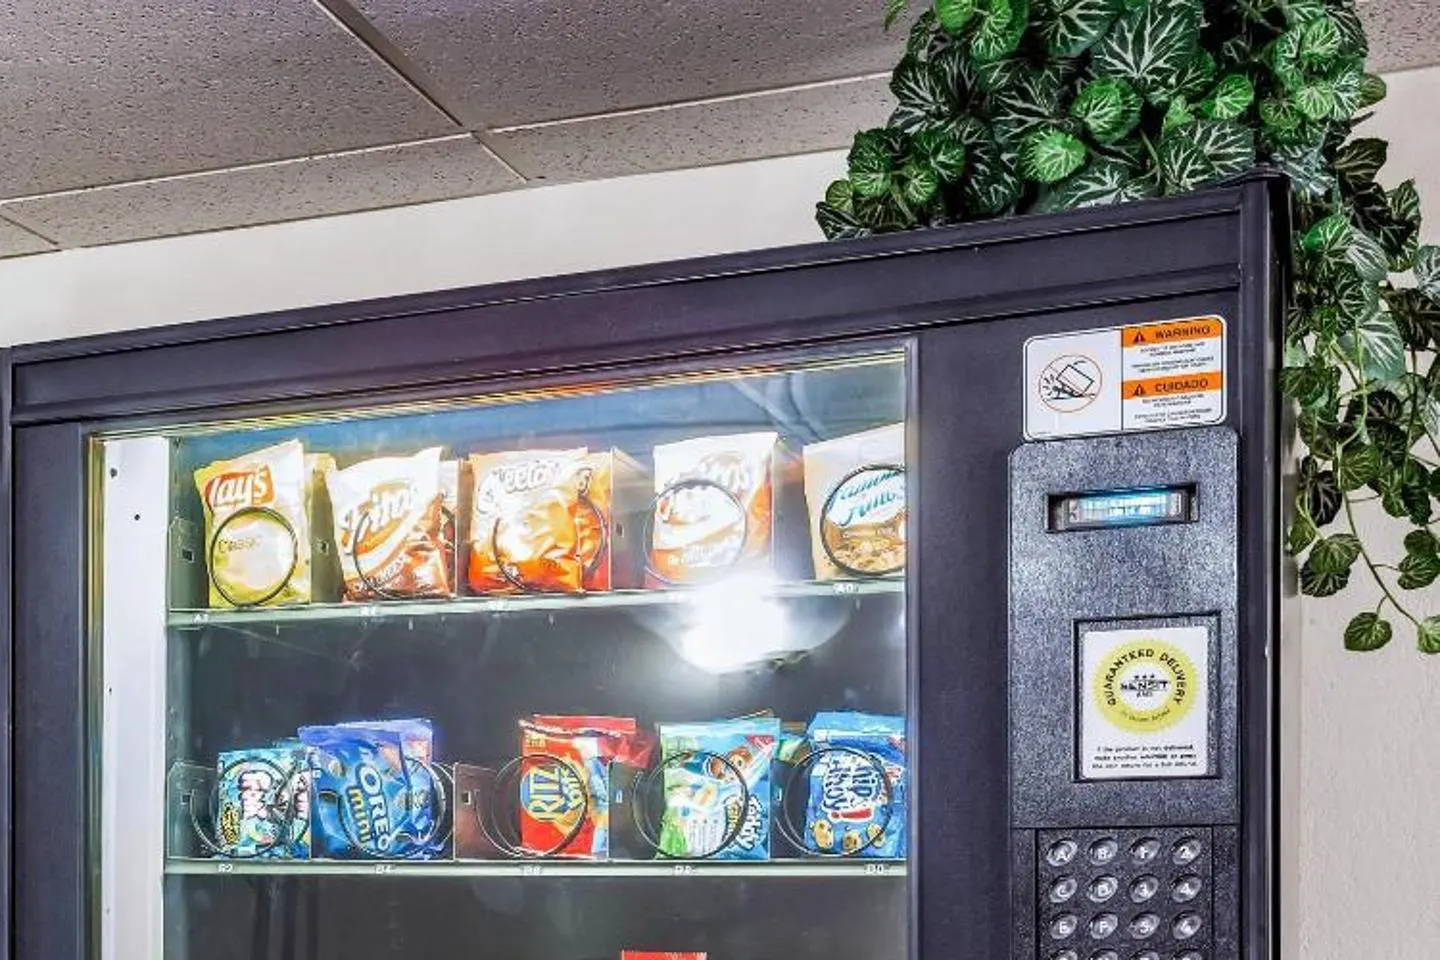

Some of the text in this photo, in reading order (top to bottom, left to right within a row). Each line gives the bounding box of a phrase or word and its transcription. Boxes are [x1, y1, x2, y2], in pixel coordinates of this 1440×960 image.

[1155, 325, 1211, 339] WARNING
[1154, 379, 1209, 392] CUIDADO
[1103, 649, 1187, 706] GUARANTEED DELIVERY
[359, 764, 391, 852] OREO
[528, 766, 565, 820] RITZ
